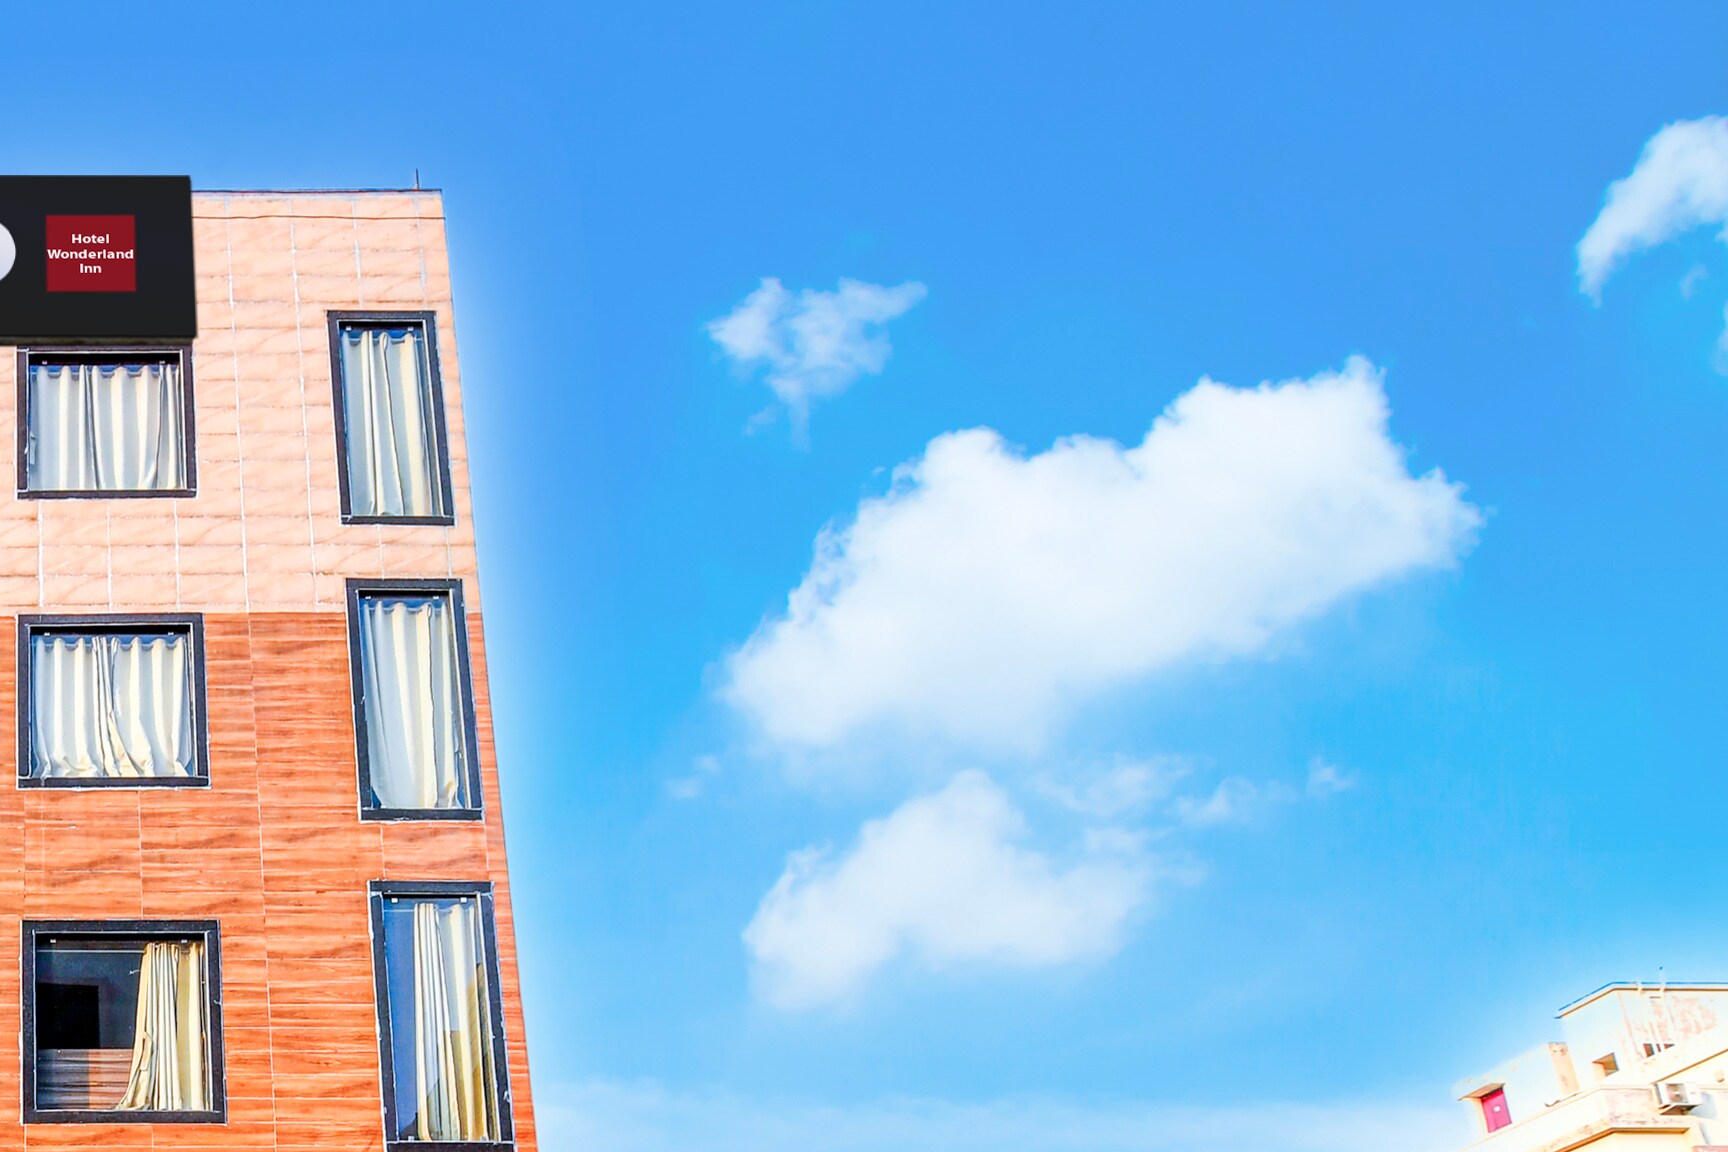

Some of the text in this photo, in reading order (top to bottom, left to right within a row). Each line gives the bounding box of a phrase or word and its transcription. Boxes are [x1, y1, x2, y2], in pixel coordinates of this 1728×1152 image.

[71, 233, 110, 244] Hotel
[47, 248, 134, 260] Wonderland
[79, 263, 102, 274] Inn
